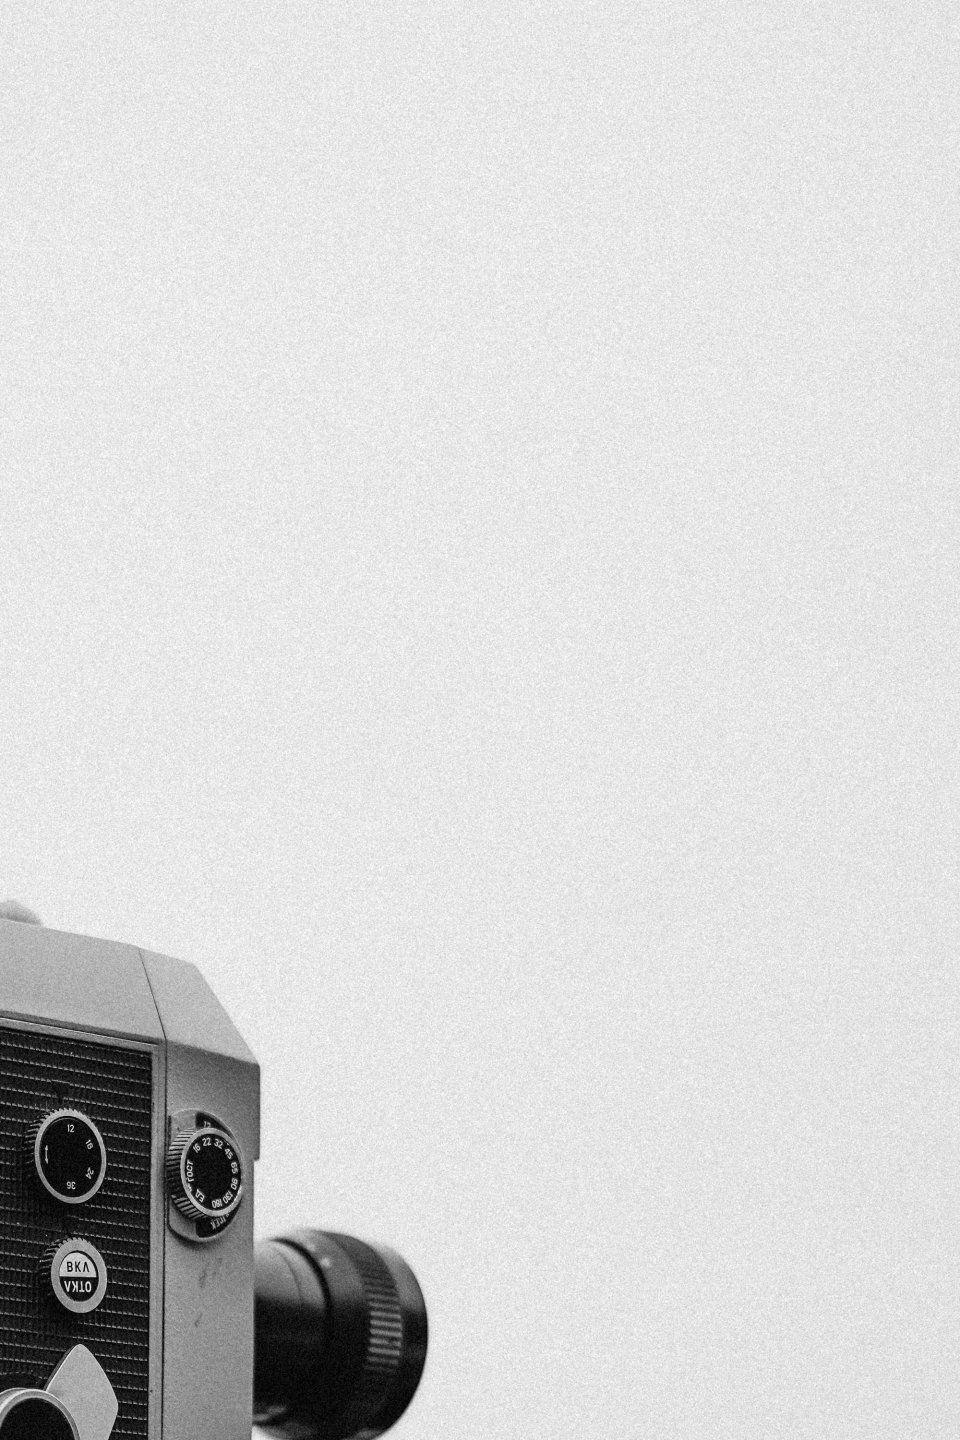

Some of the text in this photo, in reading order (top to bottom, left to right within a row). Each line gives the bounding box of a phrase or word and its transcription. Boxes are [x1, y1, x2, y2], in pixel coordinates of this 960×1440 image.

[67, 1124, 75, 1133] 12
[85, 1139, 94, 1150] 16
[193, 1143, 201, 1153] 16
[202, 1137, 212, 1147] 22
[213, 1138, 223, 1149] 32
[224, 1148, 234, 1160] 45
[85, 1167, 95, 1180] 24
[186, 1159, 195, 1182] ГОСТ
[230, 1161, 239, 1174] 65
[66, 1181, 77, 1190] 36
[230, 1177, 239, 1191] 90
[222, 1190, 233, 1204] 130
[211, 1199, 223, 1209] 180
[66, 1260, 90, 1273] ВКЛ
[64, 1280, 92, 1293] ОТКЛ
